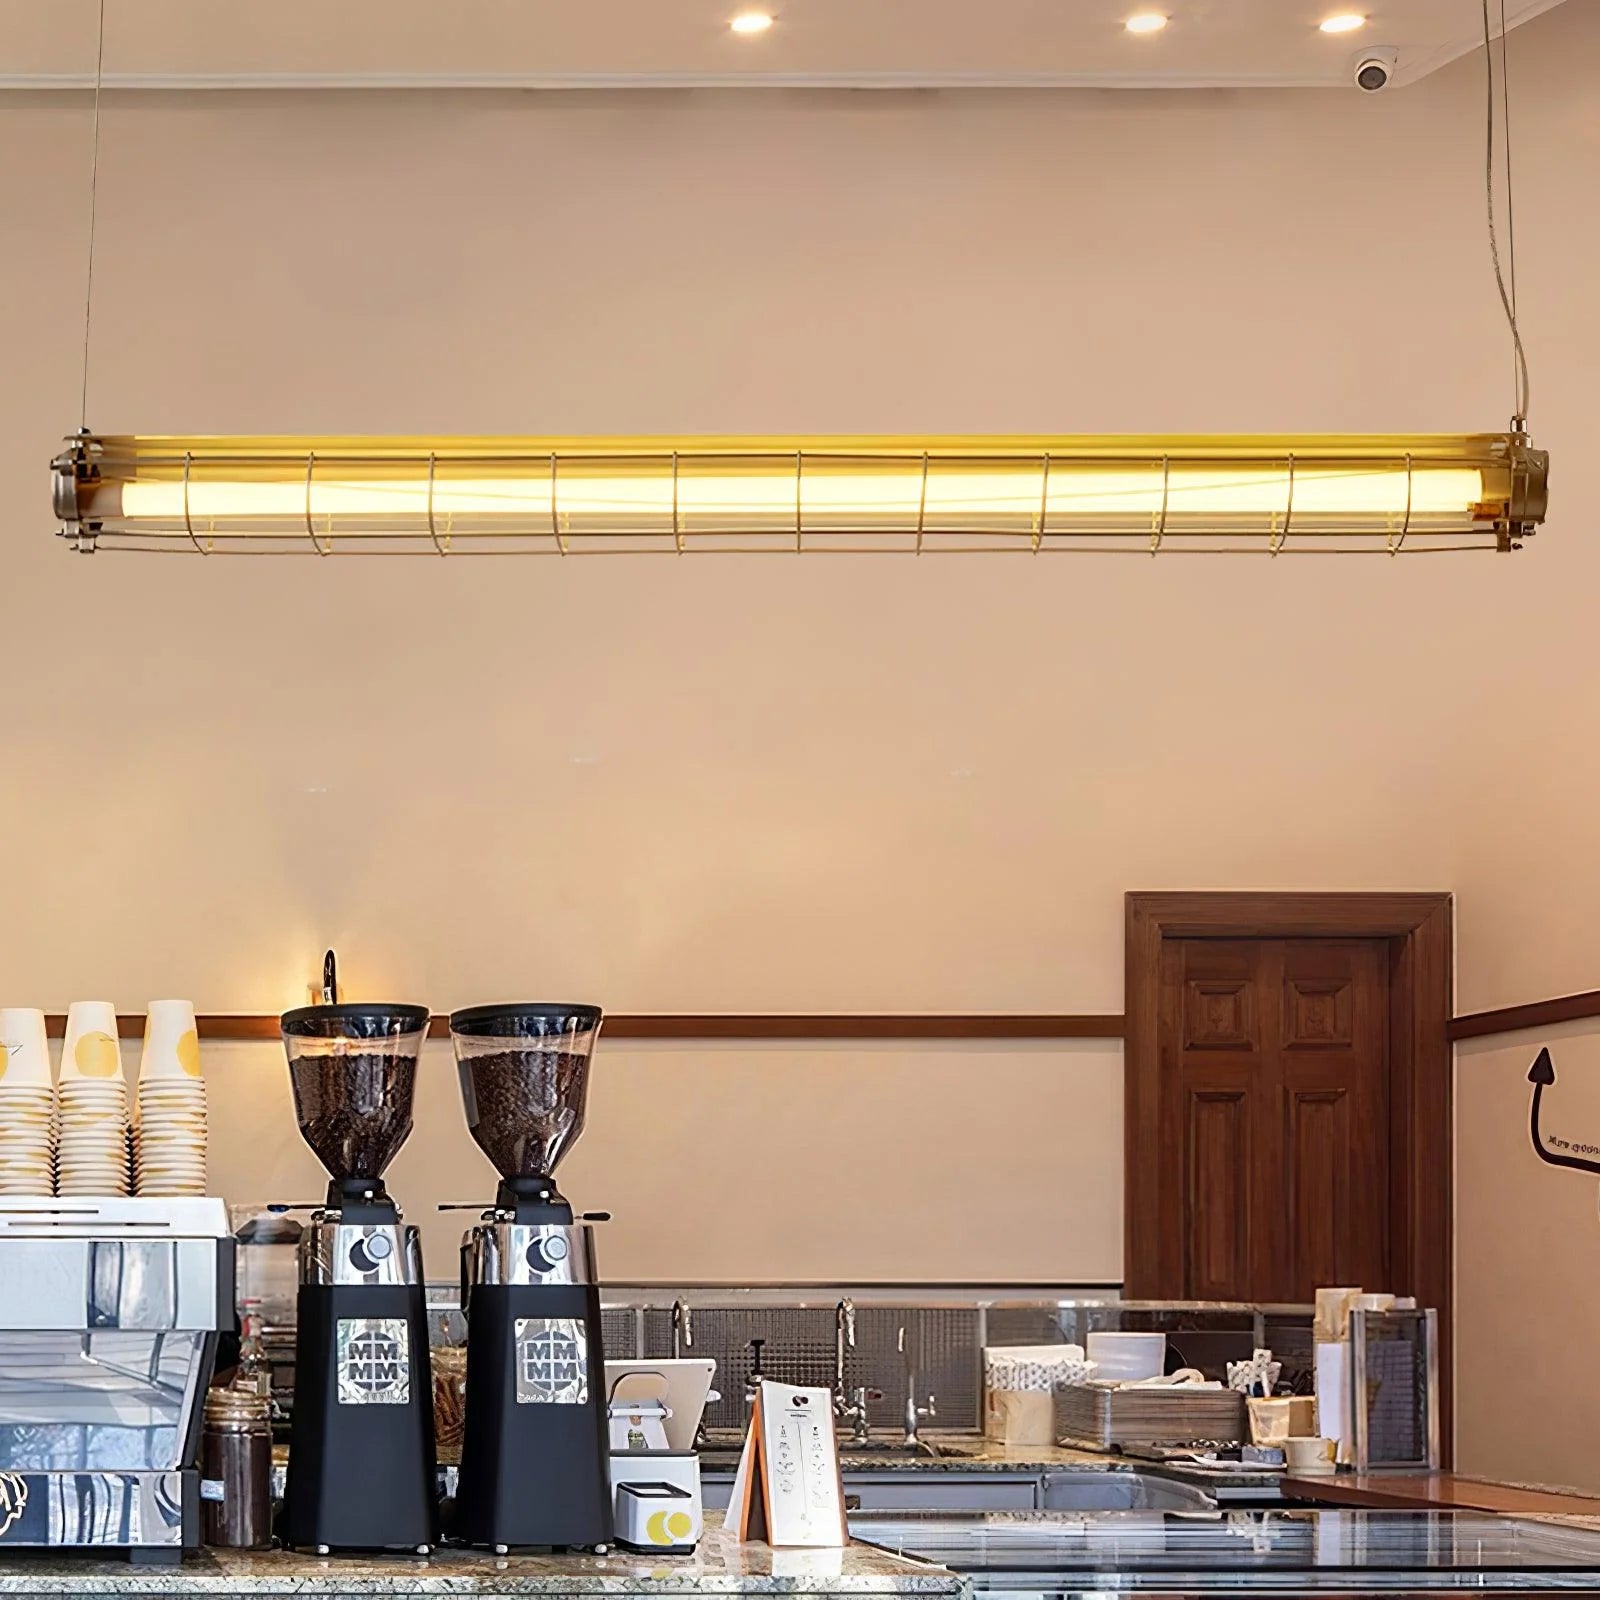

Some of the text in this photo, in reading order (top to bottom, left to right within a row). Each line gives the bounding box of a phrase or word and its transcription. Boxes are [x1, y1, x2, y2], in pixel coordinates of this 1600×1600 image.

[349, 1343, 398, 1360] MM
[527, 1343, 576, 1360] MM
[349, 1363, 398, 1380] MM
[528, 1362, 577, 1380] MM
